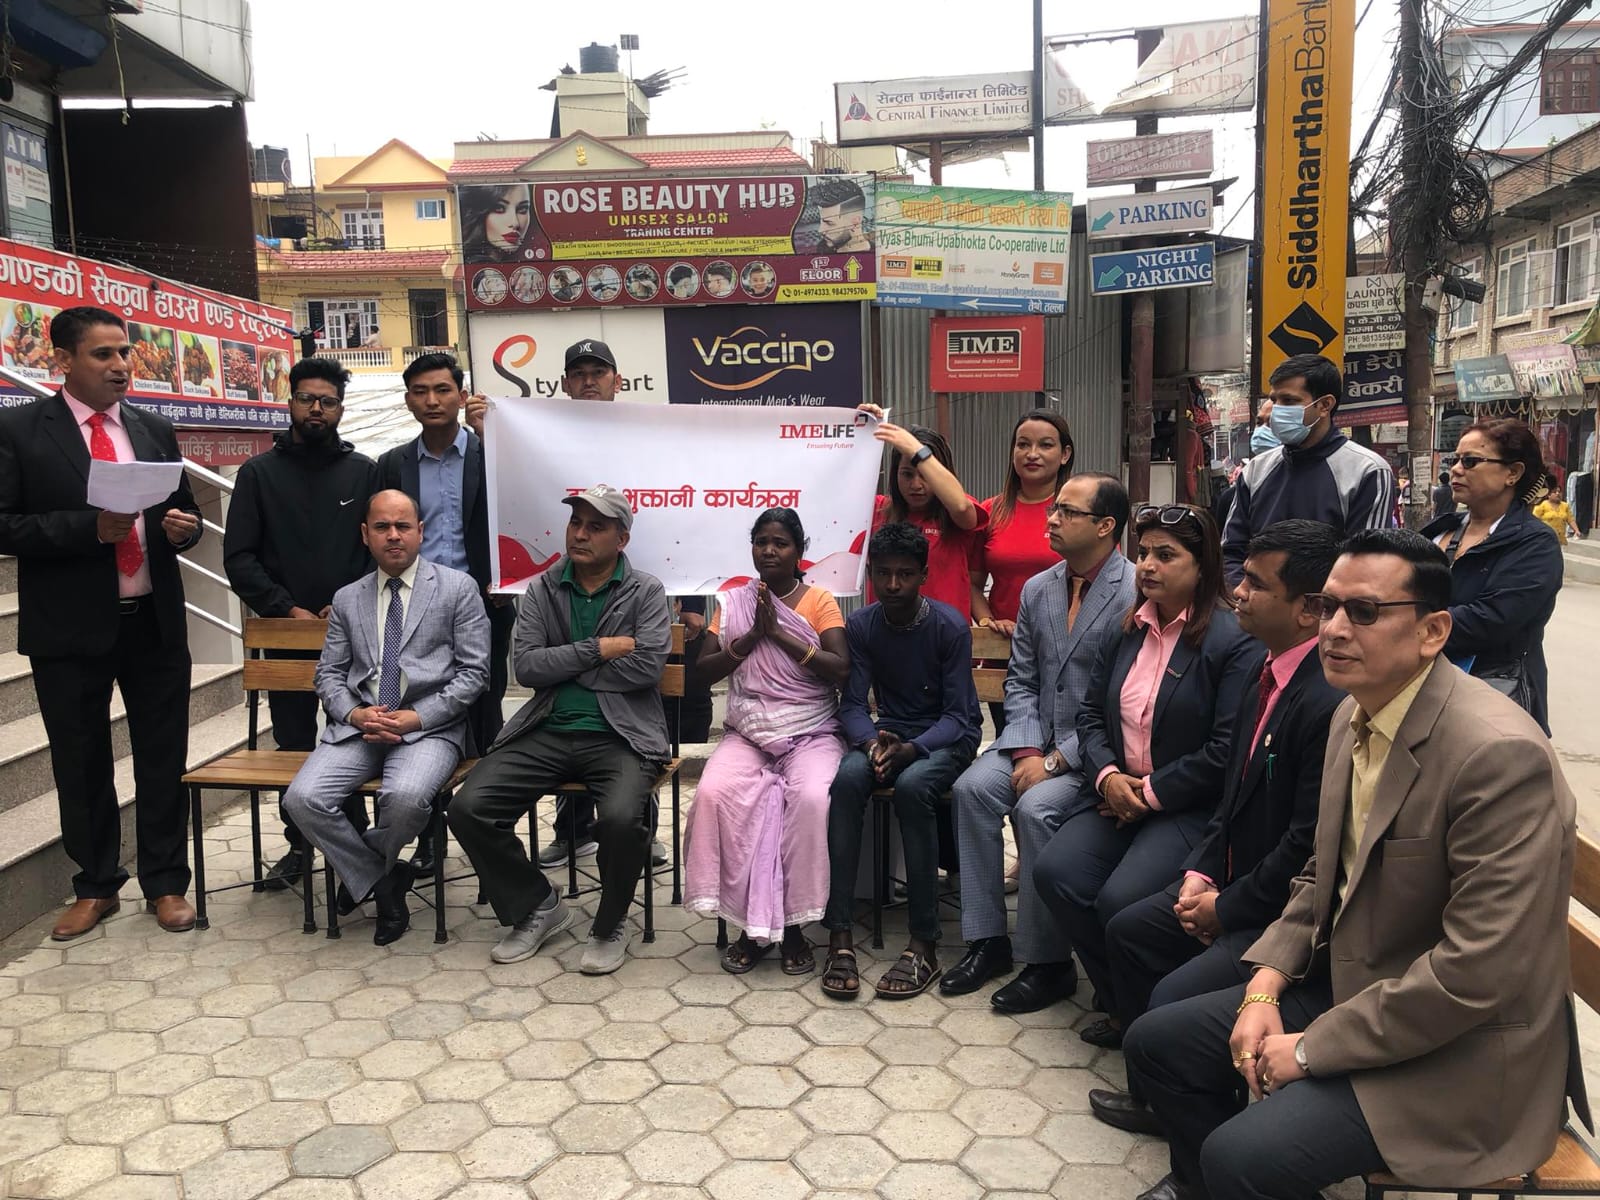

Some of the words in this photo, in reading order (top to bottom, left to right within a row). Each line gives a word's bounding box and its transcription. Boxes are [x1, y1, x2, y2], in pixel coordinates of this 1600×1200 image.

[983, 83, 1028, 98] लिमिटेड
[7, 131, 42, 162] ATM
[543, 187, 614, 214] ROSE
[621, 184, 730, 212] BEAUTY
[738, 183, 796, 209] HUB
[608, 214, 669, 227] UNISEX
[676, 212, 730, 225] SALON
[1119, 199, 1207, 225] PARKING
[673, 226, 714, 237] CENTER
[880, 230, 902, 249] Vyas
[904, 230, 934, 248] Bhumi
[937, 232, 986, 251] Upabhokta
[988, 234, 1048, 255] Co-operative
[1050, 238, 1068, 254] Ltd.
[1136, 248, 1199, 268] NIGHT
[801, 268, 843, 281] FLOOR
[1125, 263, 1212, 288] PARKING
[90, 266, 150, 317] सेकुवा
[154, 290, 200, 324] हाउस
[203, 301, 235, 329] एण्ड
[1346, 287, 1402, 300] LAUNDRY
[692, 332, 835, 371] Vaccino
[960, 336, 1014, 354] IME
[1366, 351, 1403, 371] डेरी
[1348, 375, 1404, 397] बेकरी
[766, 394, 796, 407] Men's
[800, 393, 826, 406] Wear
[622, 485, 697, 514] भुक्तानी
[703, 482, 802, 508] कार्यक्रम
